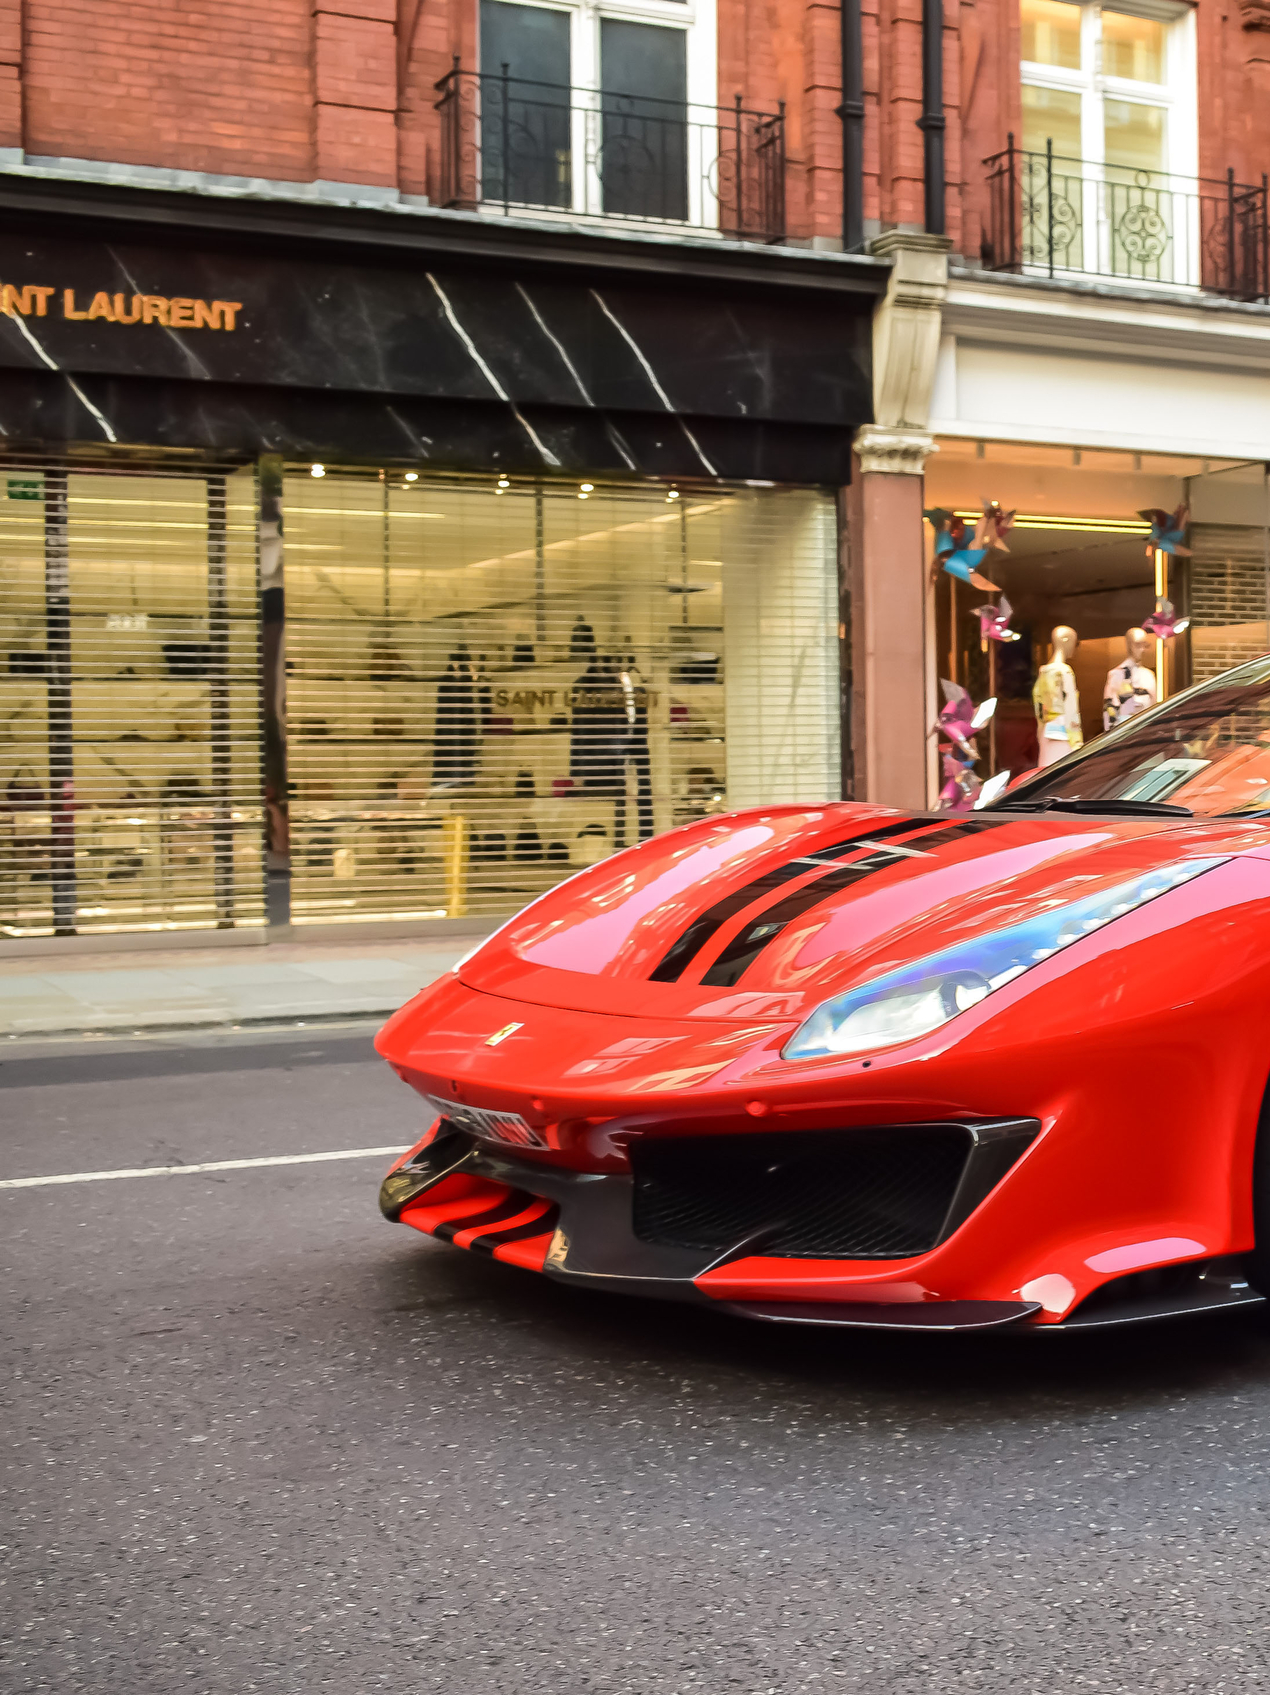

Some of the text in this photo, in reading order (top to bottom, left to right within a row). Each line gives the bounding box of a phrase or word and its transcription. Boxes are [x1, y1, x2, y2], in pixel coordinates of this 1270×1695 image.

[63, 288, 243, 331] LAURENT
[495, 688, 661, 708] SAINT LAUT
